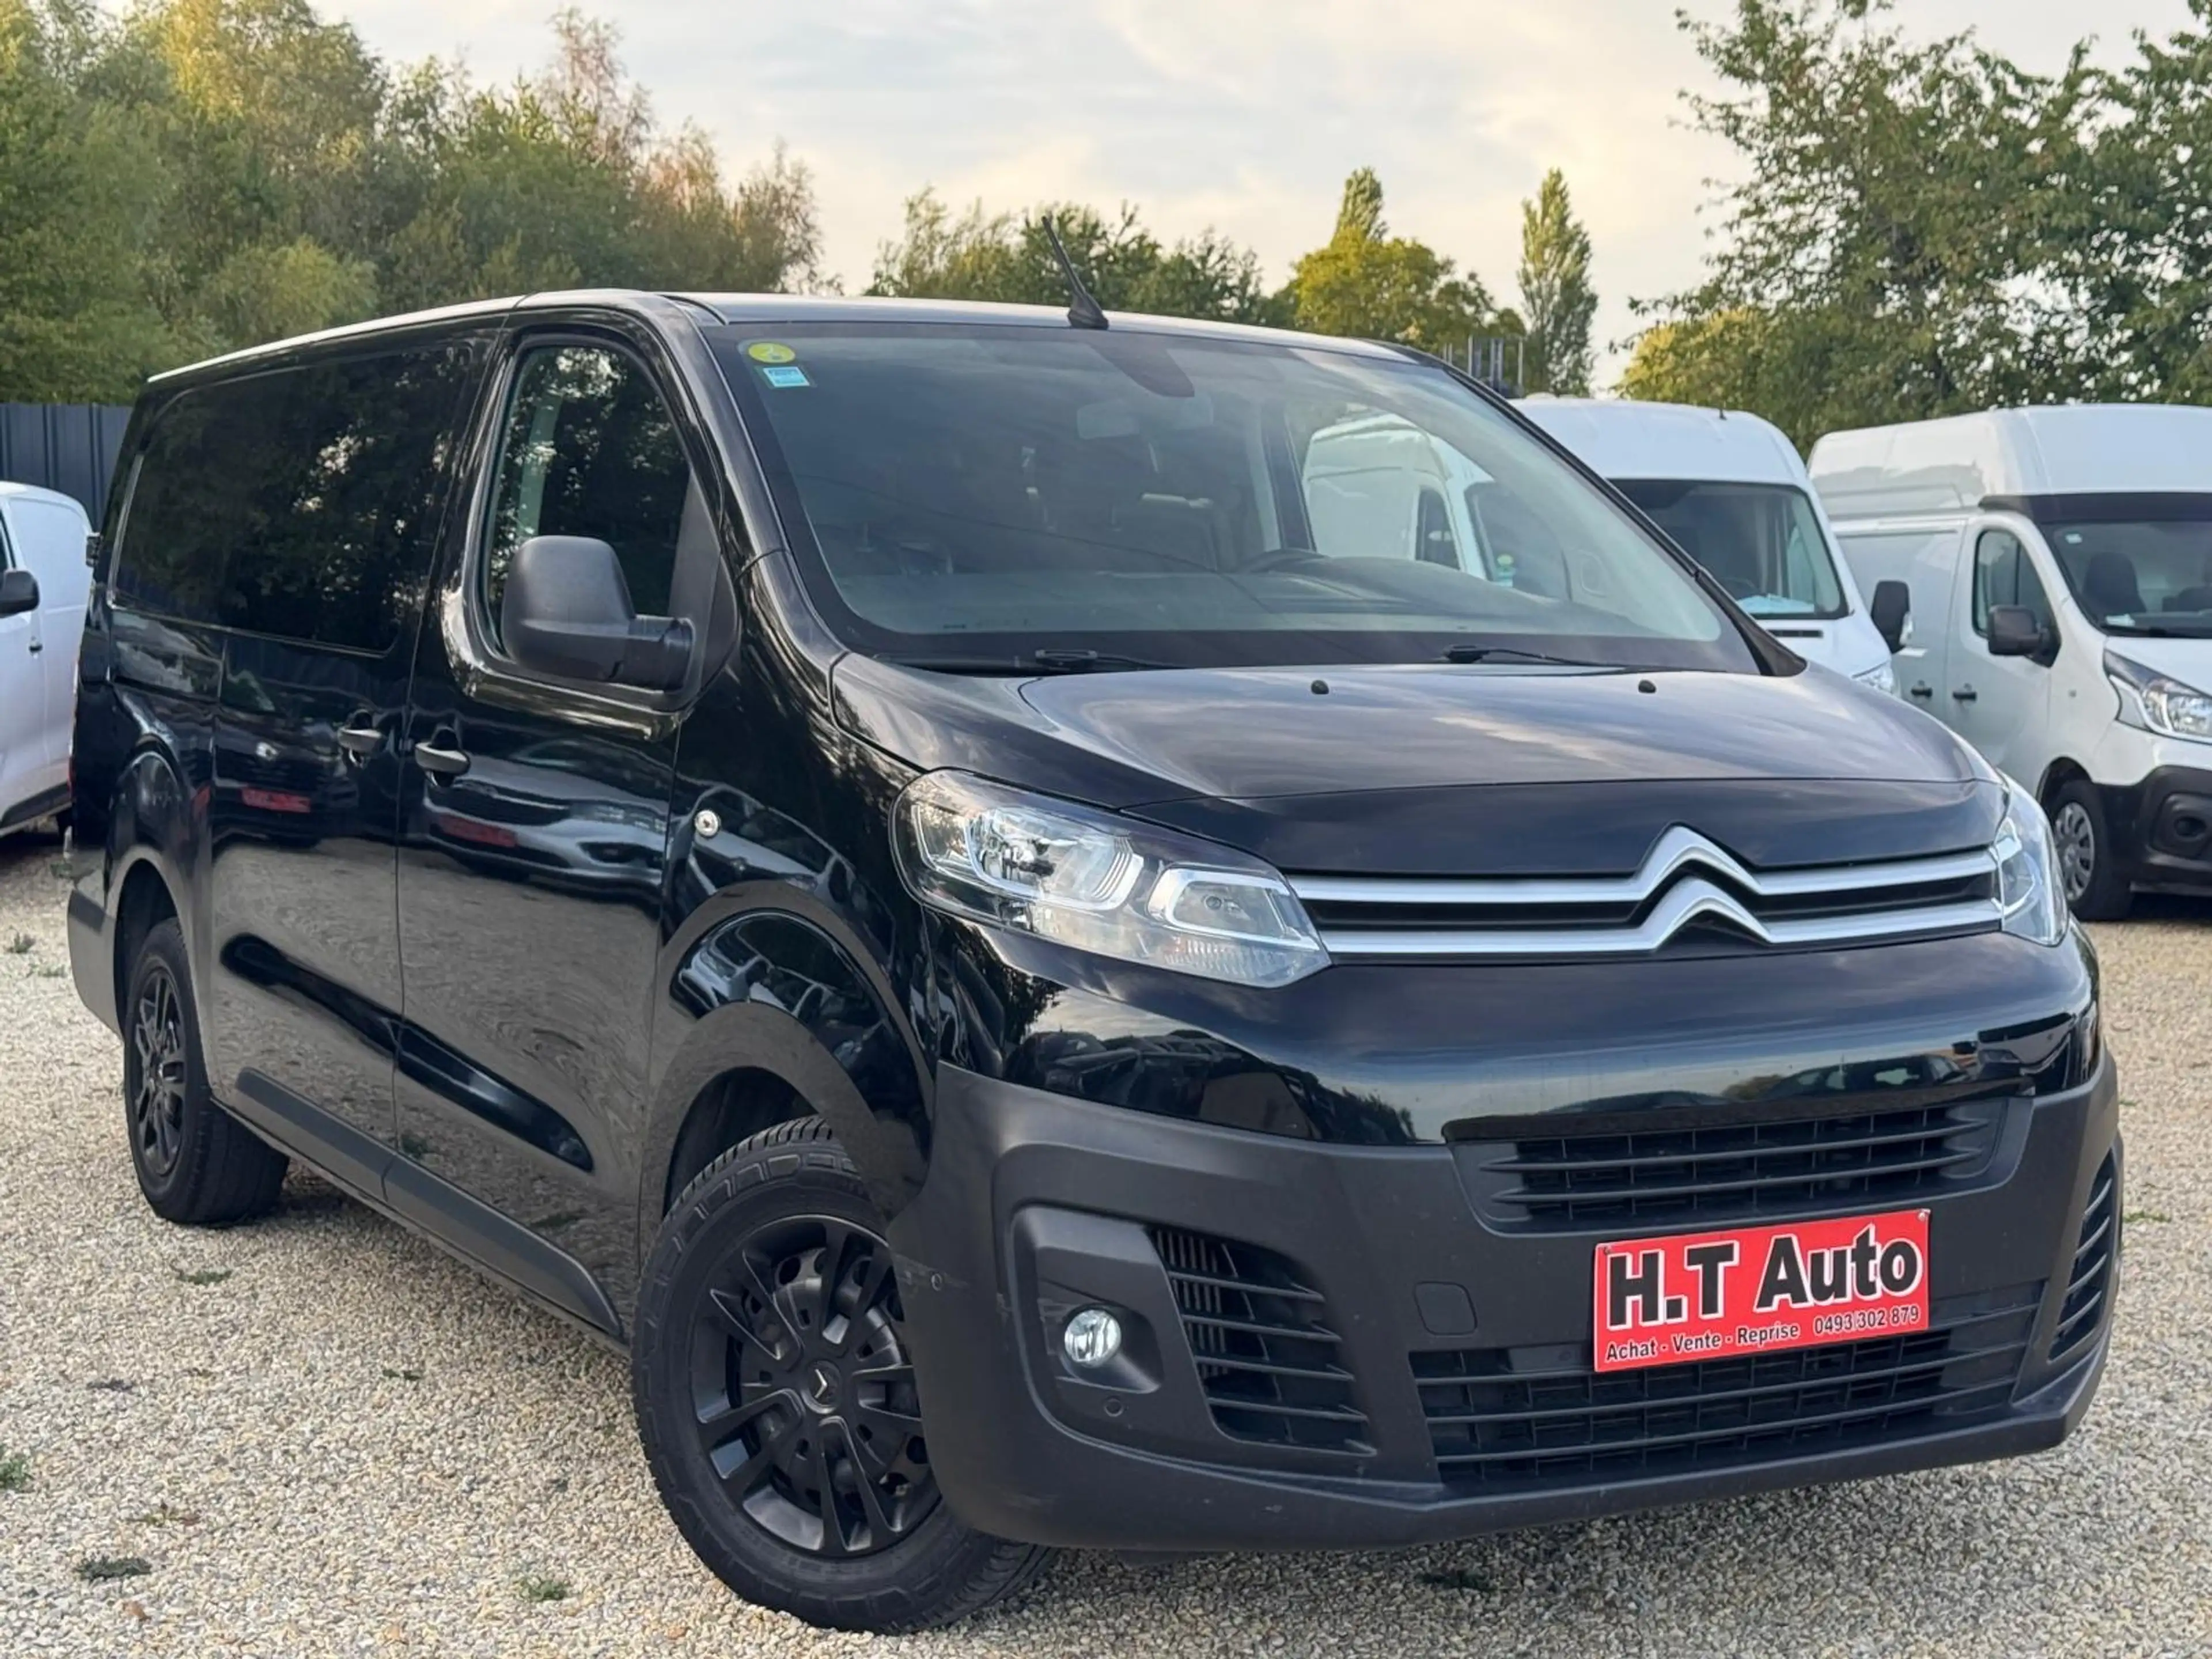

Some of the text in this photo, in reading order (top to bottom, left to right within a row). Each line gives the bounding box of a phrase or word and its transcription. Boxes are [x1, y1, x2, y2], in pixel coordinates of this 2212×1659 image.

[1607, 1222, 1922, 1330] H.T Auto
[1605, 1340, 1656, 1361] Achat
[1672, 1333, 1721, 1352] Vente
[1737, 1325, 1798, 1344] Reprise
[1891, 1305, 1919, 1324] 879
